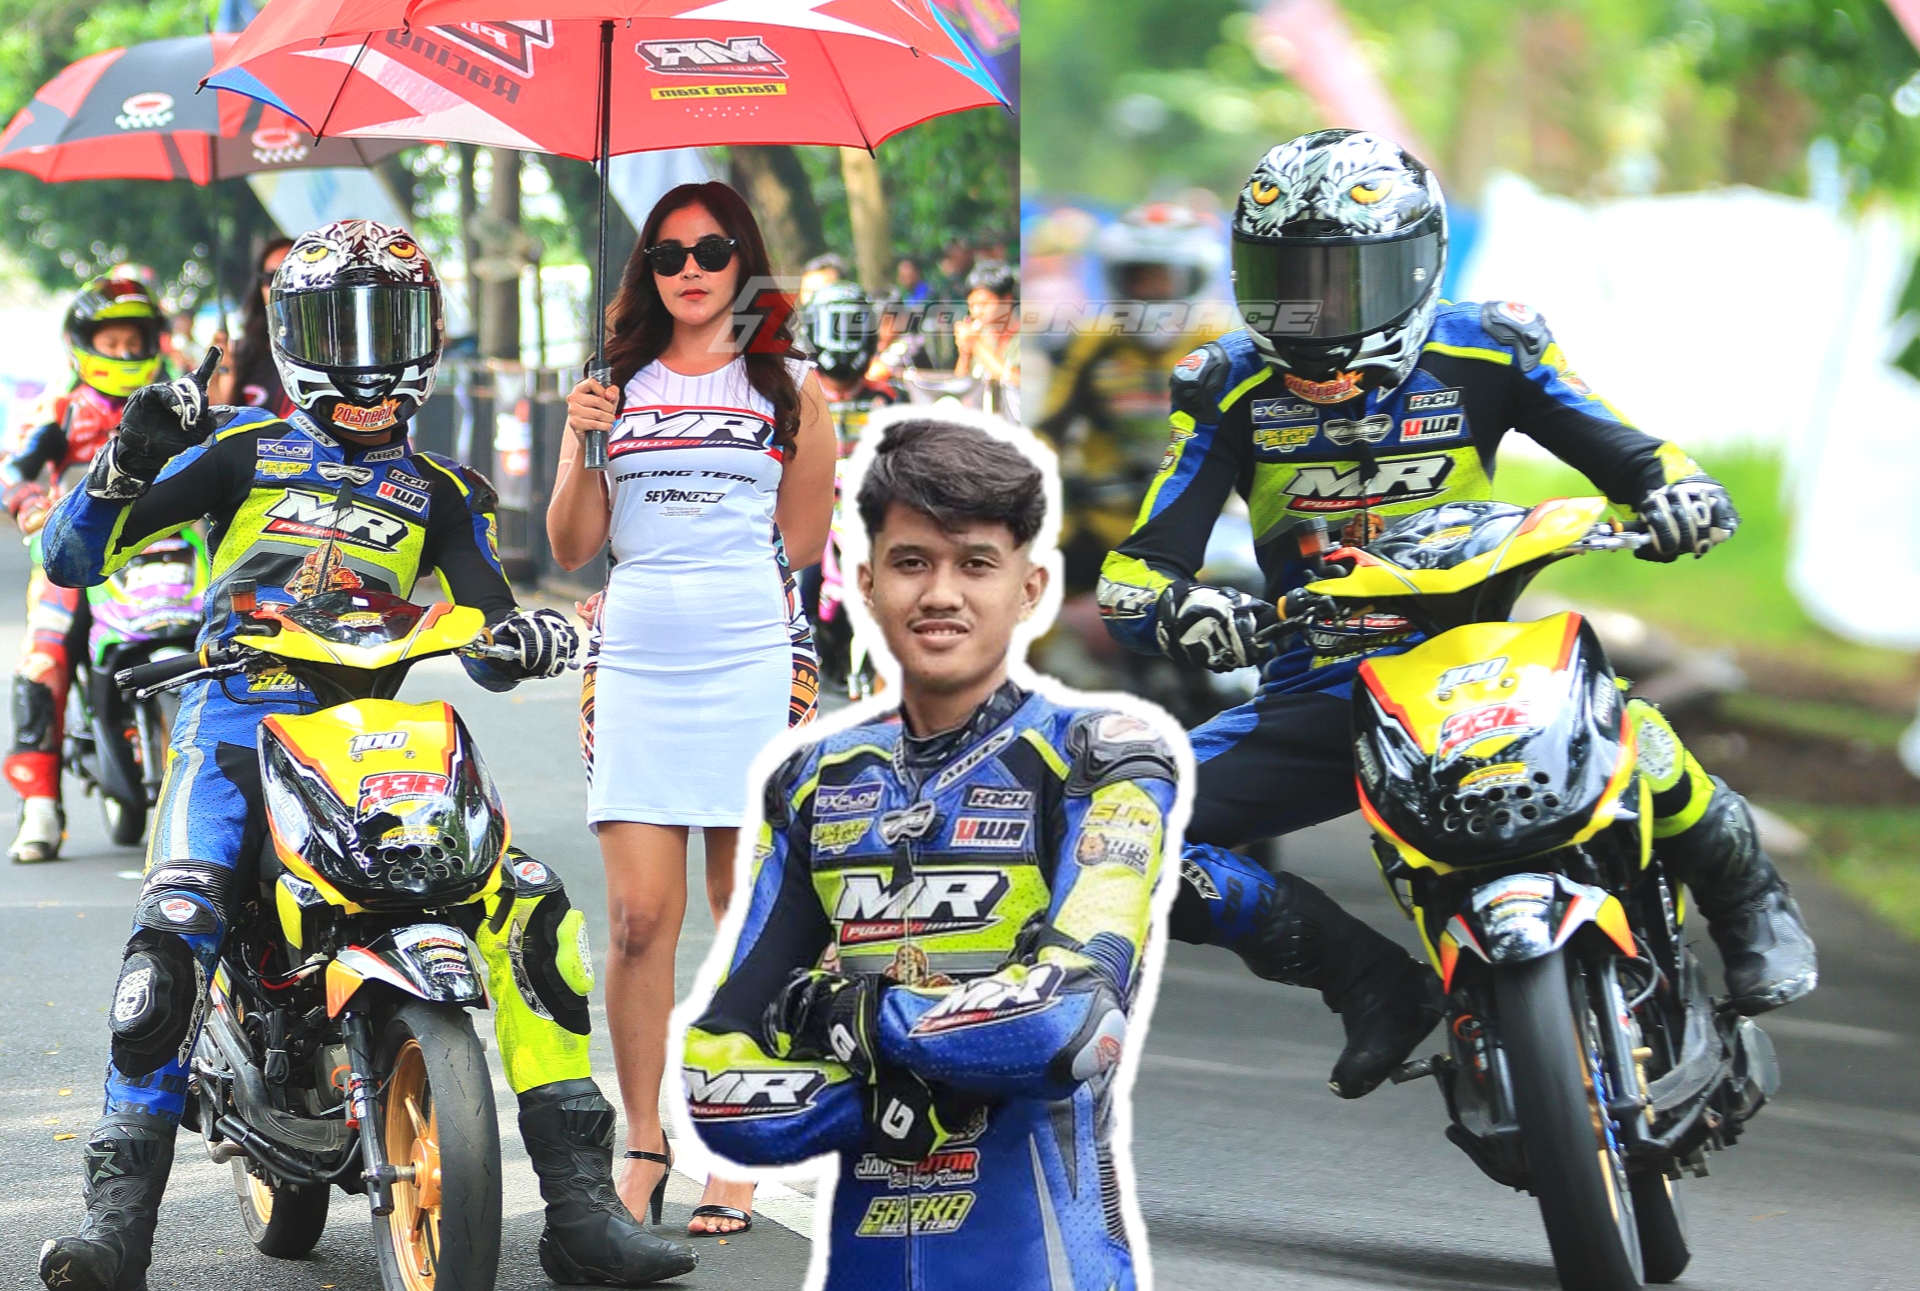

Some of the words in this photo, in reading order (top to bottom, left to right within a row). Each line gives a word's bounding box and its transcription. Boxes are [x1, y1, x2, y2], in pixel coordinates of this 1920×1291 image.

[609, 413, 766, 443] MR
[615, 470, 694, 485] RACING
[700, 470, 758, 485] TEAM
[1285, 456, 1447, 497] MR
[266, 490, 404, 545] MR
[351, 732, 407, 753] 100
[836, 875, 1000, 920] MR
